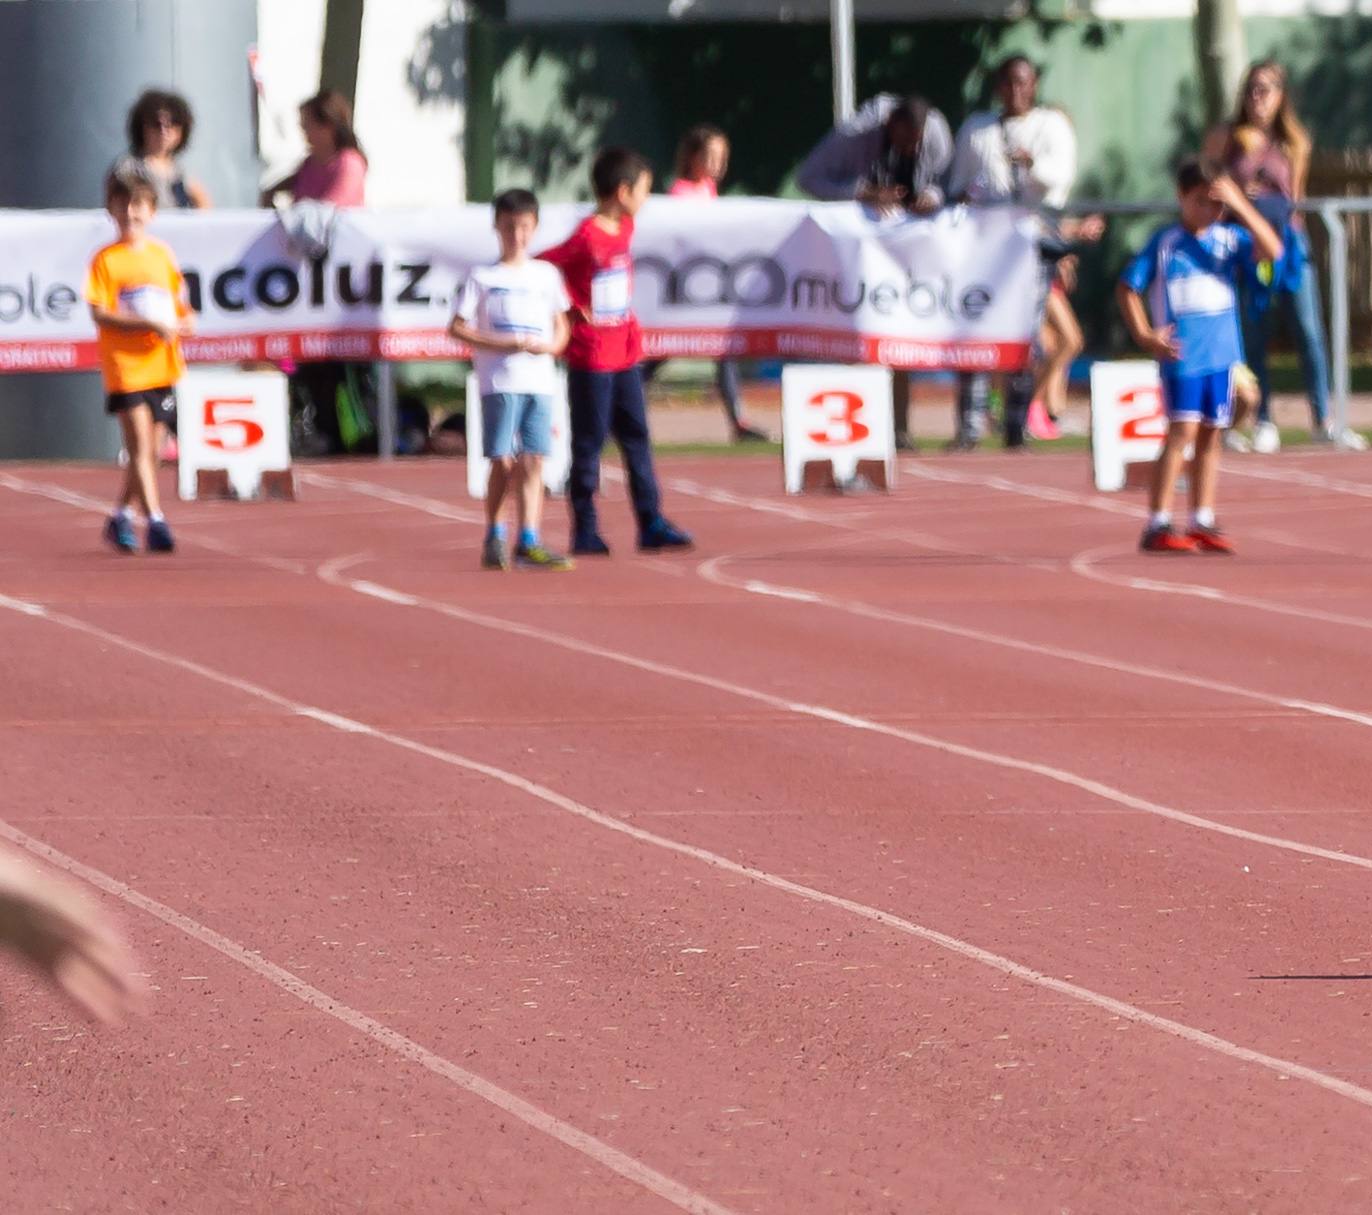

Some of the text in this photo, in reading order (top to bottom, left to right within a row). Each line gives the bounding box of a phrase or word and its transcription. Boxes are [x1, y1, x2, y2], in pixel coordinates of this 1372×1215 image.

[203, 396, 264, 453] 5
[807, 390, 870, 446] 3
[1118, 387, 1168, 441] 2
